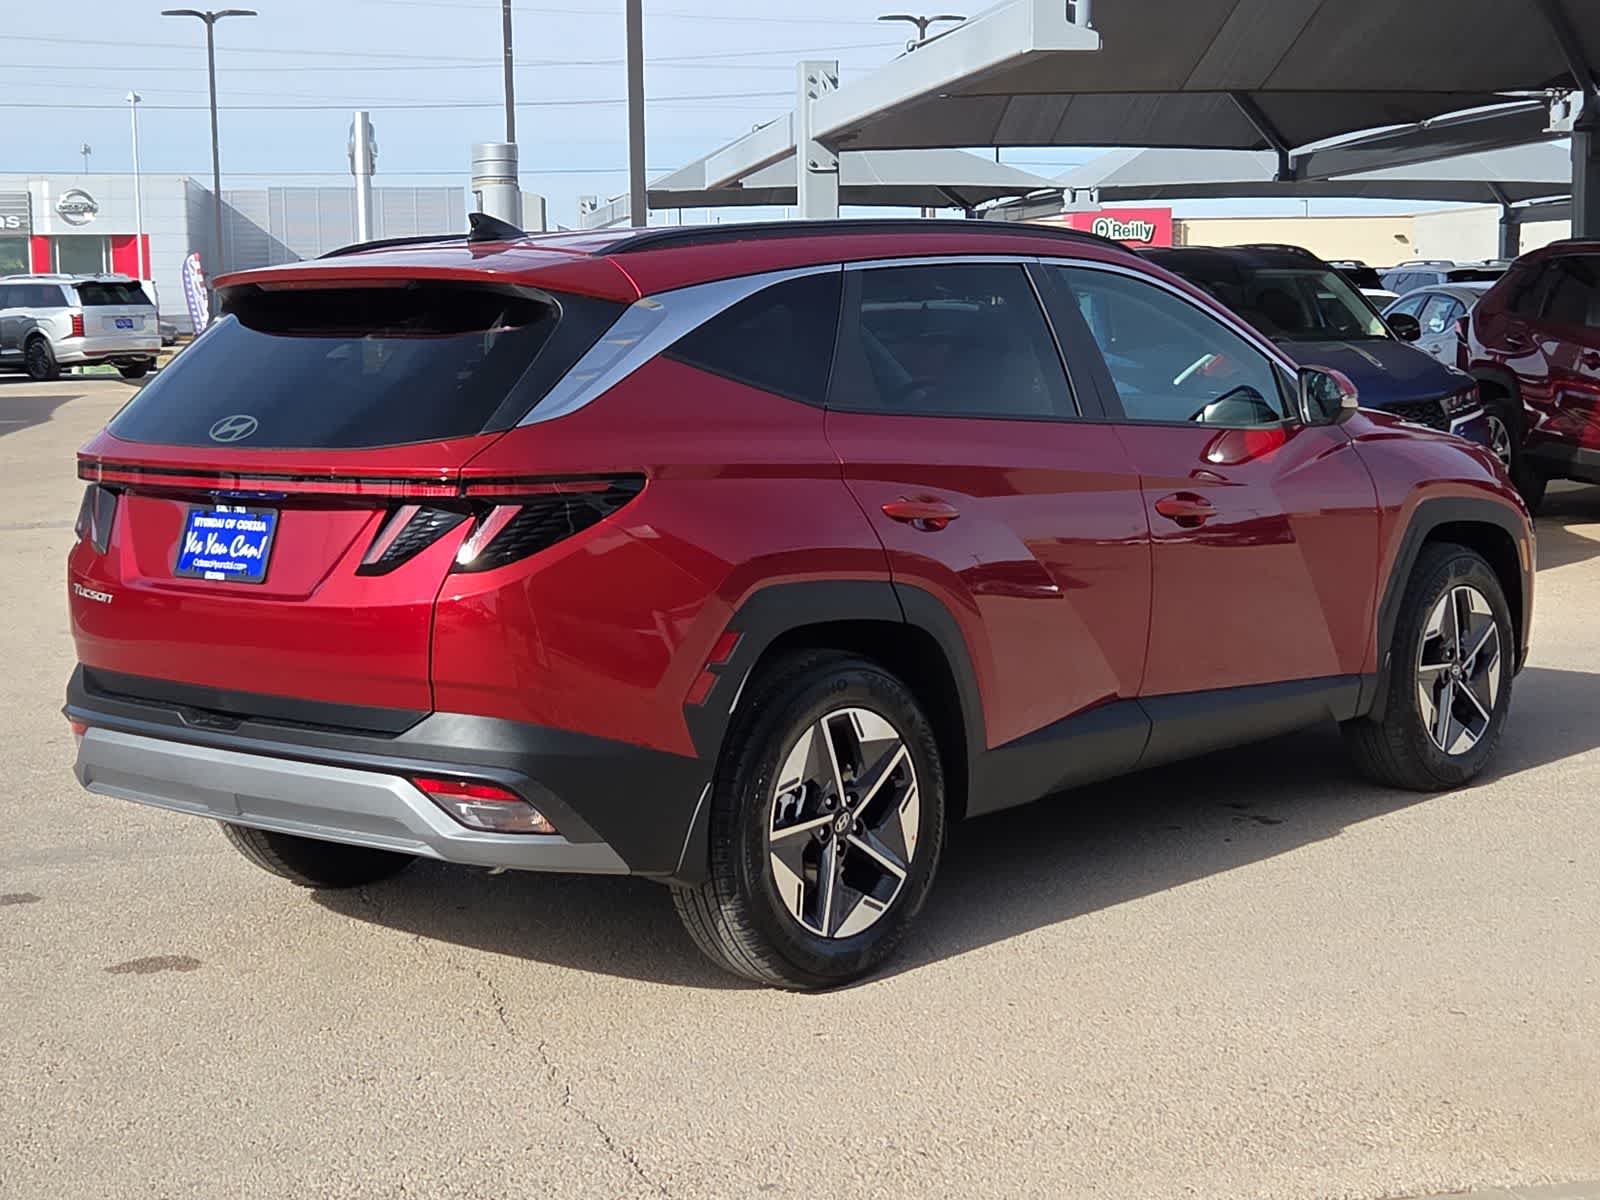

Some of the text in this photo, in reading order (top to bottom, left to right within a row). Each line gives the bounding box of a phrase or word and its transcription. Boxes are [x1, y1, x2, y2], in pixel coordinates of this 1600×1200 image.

[1094, 218, 1154, 241] O'Reilly
[184, 531, 268, 559] Yes You Can!
